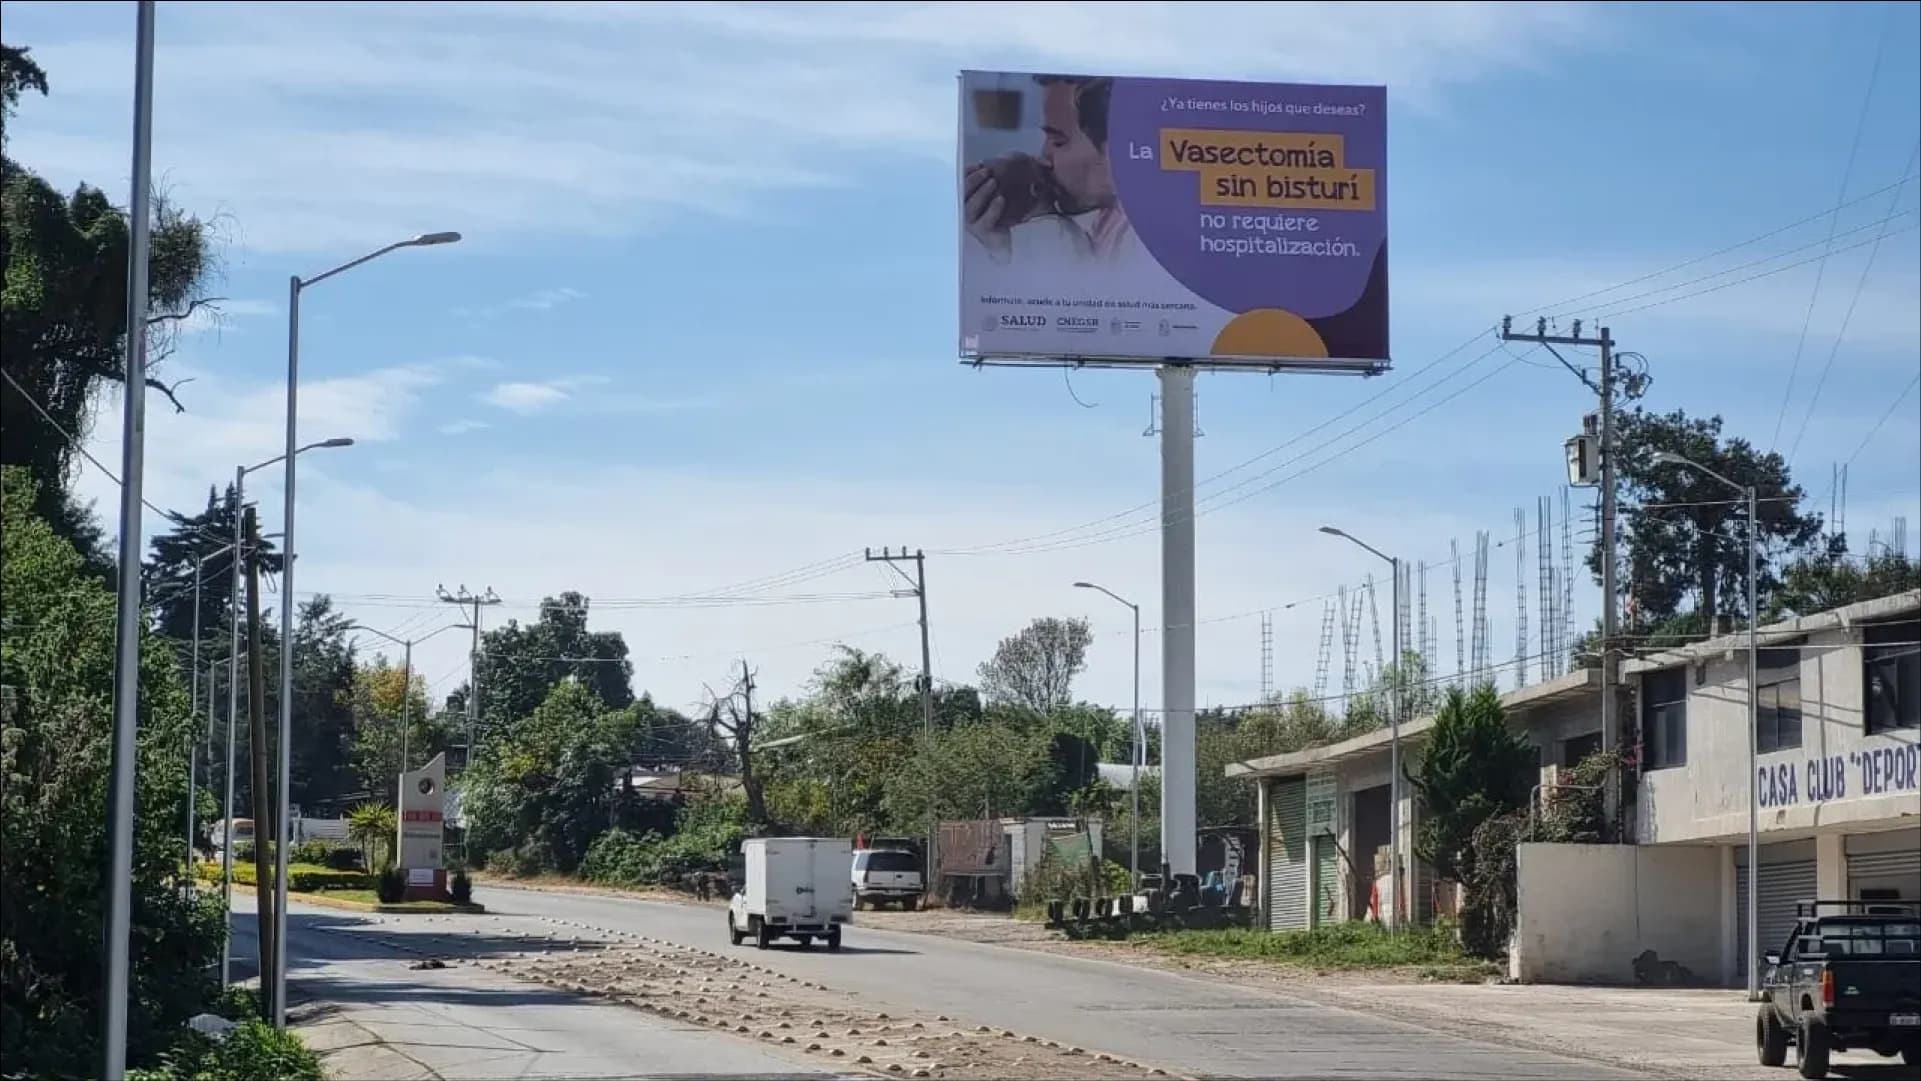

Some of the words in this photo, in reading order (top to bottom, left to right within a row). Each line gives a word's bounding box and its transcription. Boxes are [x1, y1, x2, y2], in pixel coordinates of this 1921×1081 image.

[1160, 97, 1184, 112] ¿Ya
[1187, 98, 1227, 111] tienes
[1230, 99, 1249, 112] los
[1252, 99, 1282, 115] hijos
[1285, 103, 1310, 116] que
[1313, 102, 1366, 116] deseas?
[1129, 141, 1153, 160] La
[1169, 139, 1335, 169] Vasectomía
[1216, 174, 1257, 198] sin
[1266, 173, 1360, 201] bisturí
[1200, 213, 1226, 229] no
[1232, 213, 1320, 235] requiere
[1200, 236, 1361, 258] hospitalización.
[1000, 315, 1047, 326] SALUD
[1758, 762, 1798, 808] CASA
[1807, 756, 1845, 802] CLUB
